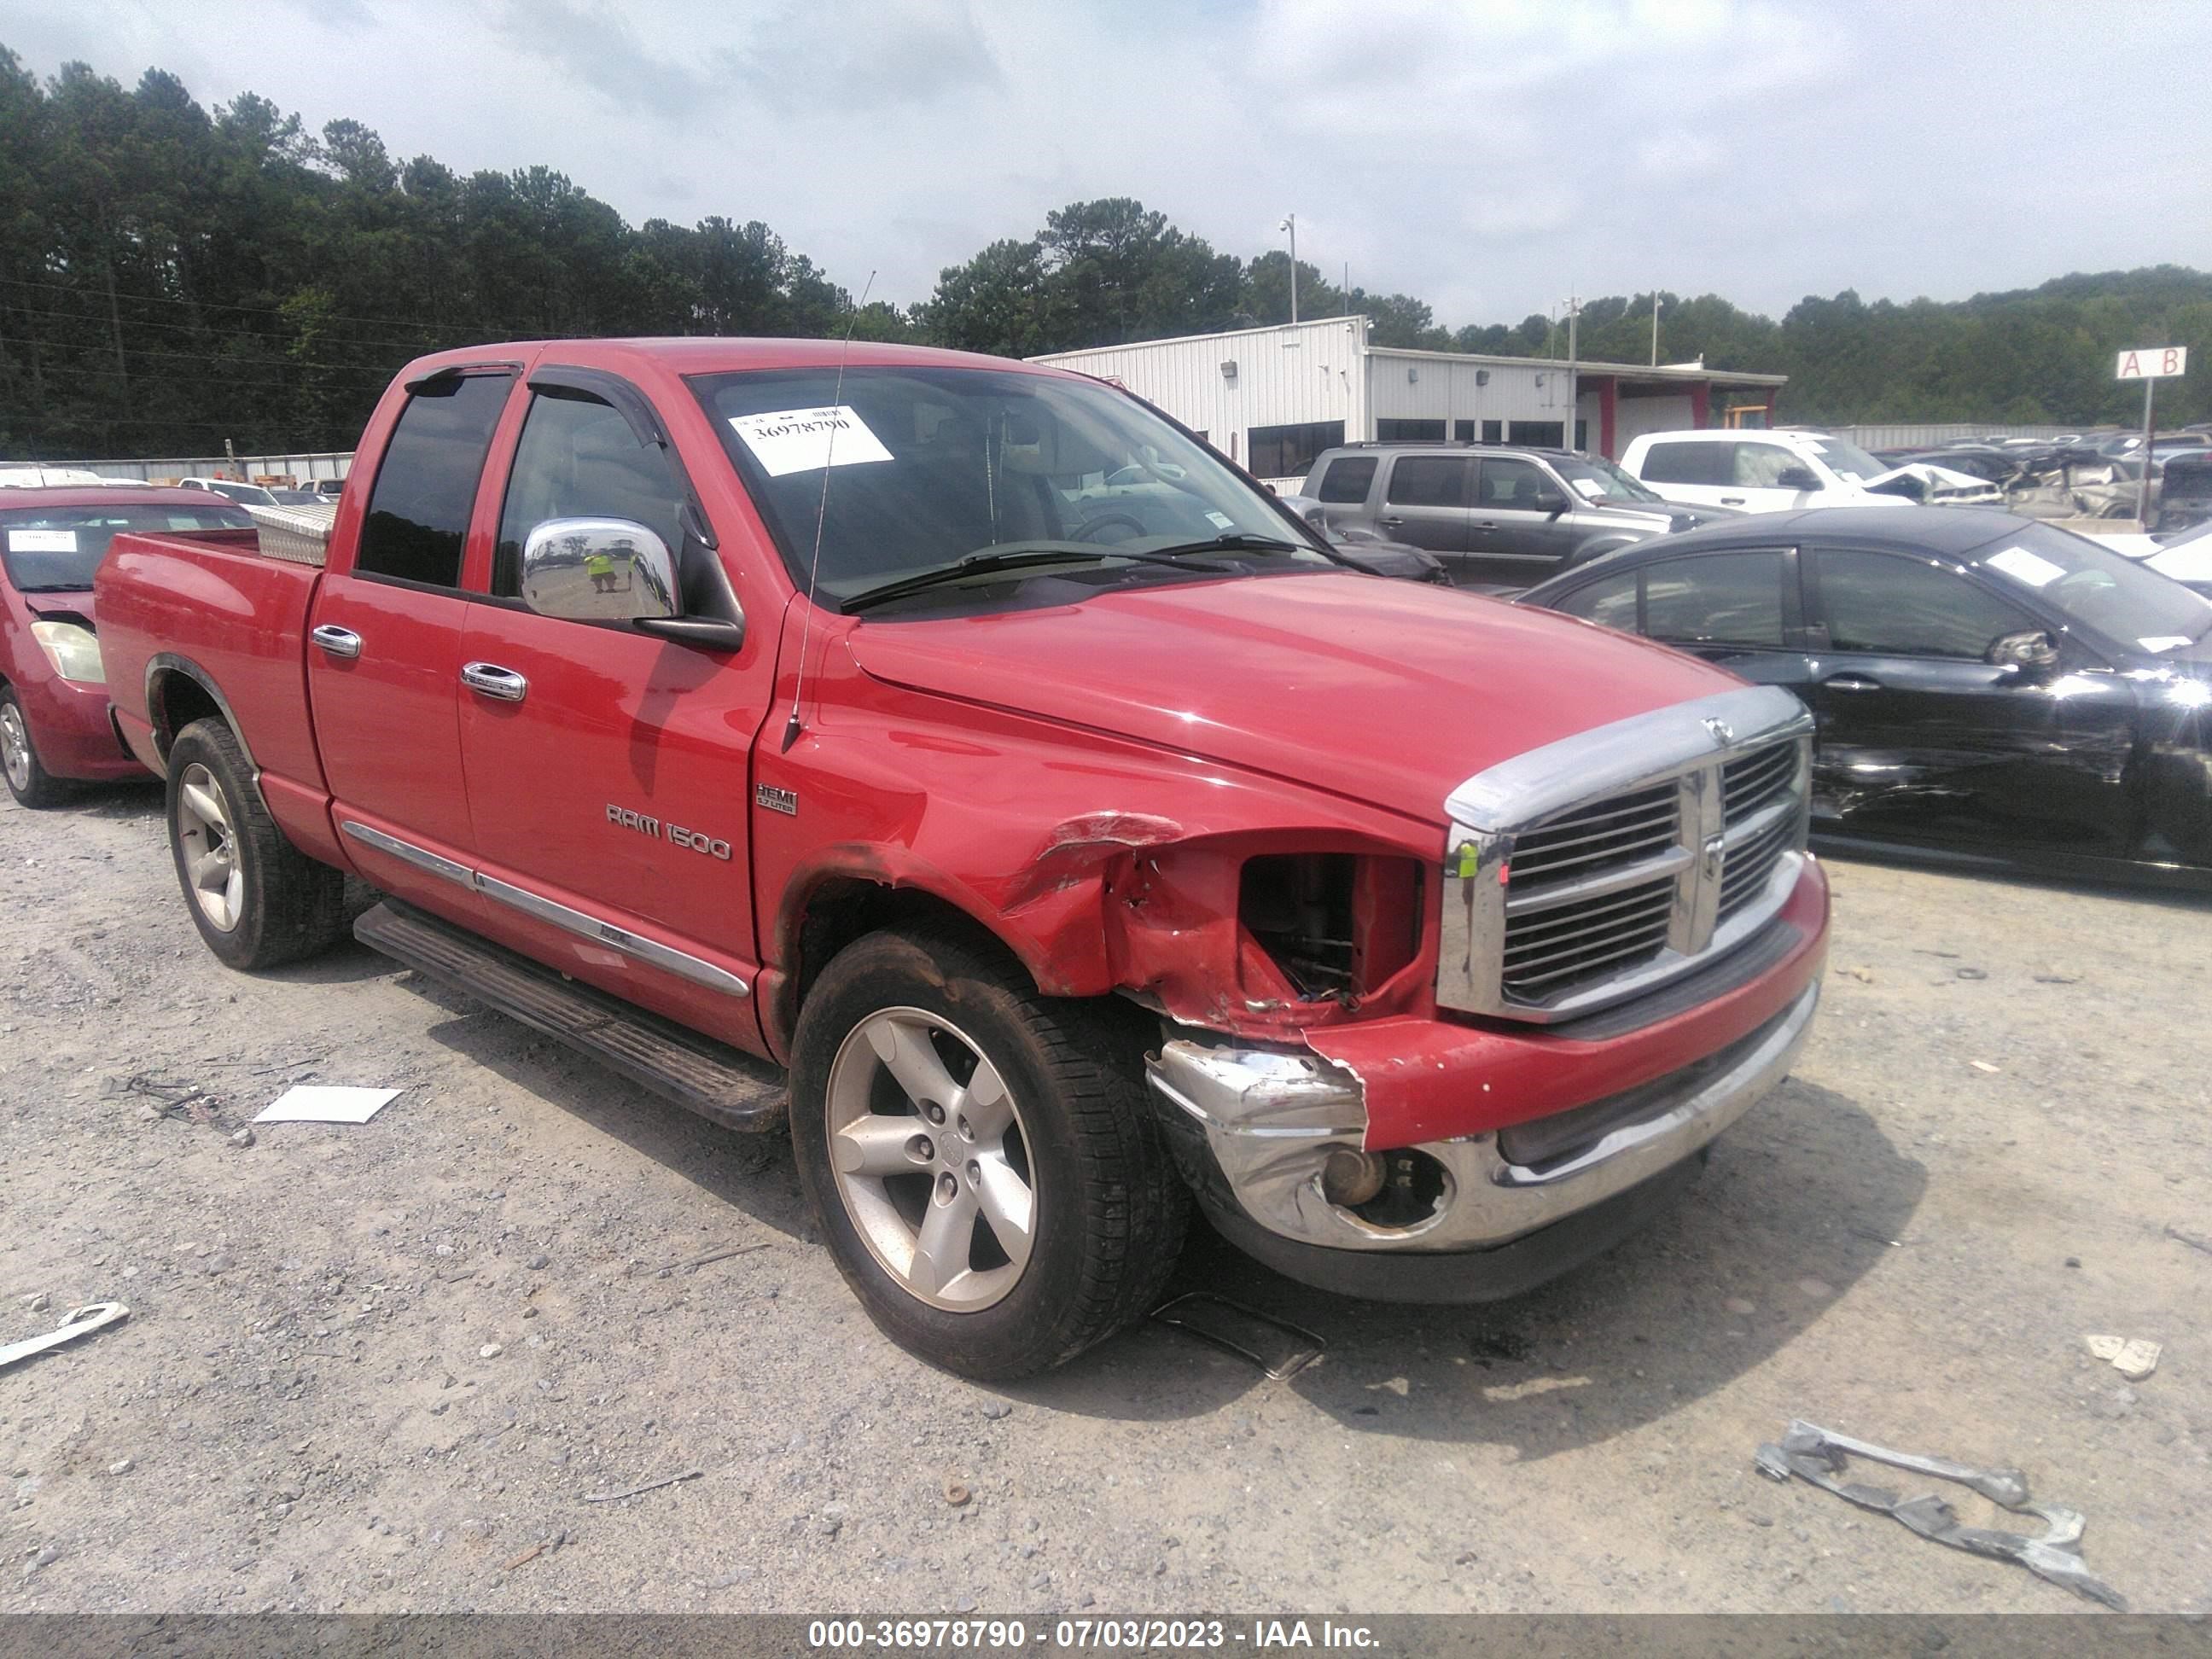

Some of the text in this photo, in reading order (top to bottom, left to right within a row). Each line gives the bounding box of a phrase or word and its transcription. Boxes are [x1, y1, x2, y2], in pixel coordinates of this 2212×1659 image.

[2121, 348, 2179, 377] A B
[753, 419, 851, 439] 36978790
[756, 783, 797, 805] HEMI
[771, 800, 794, 813] LITER
[606, 803, 732, 861] RAM 1500
